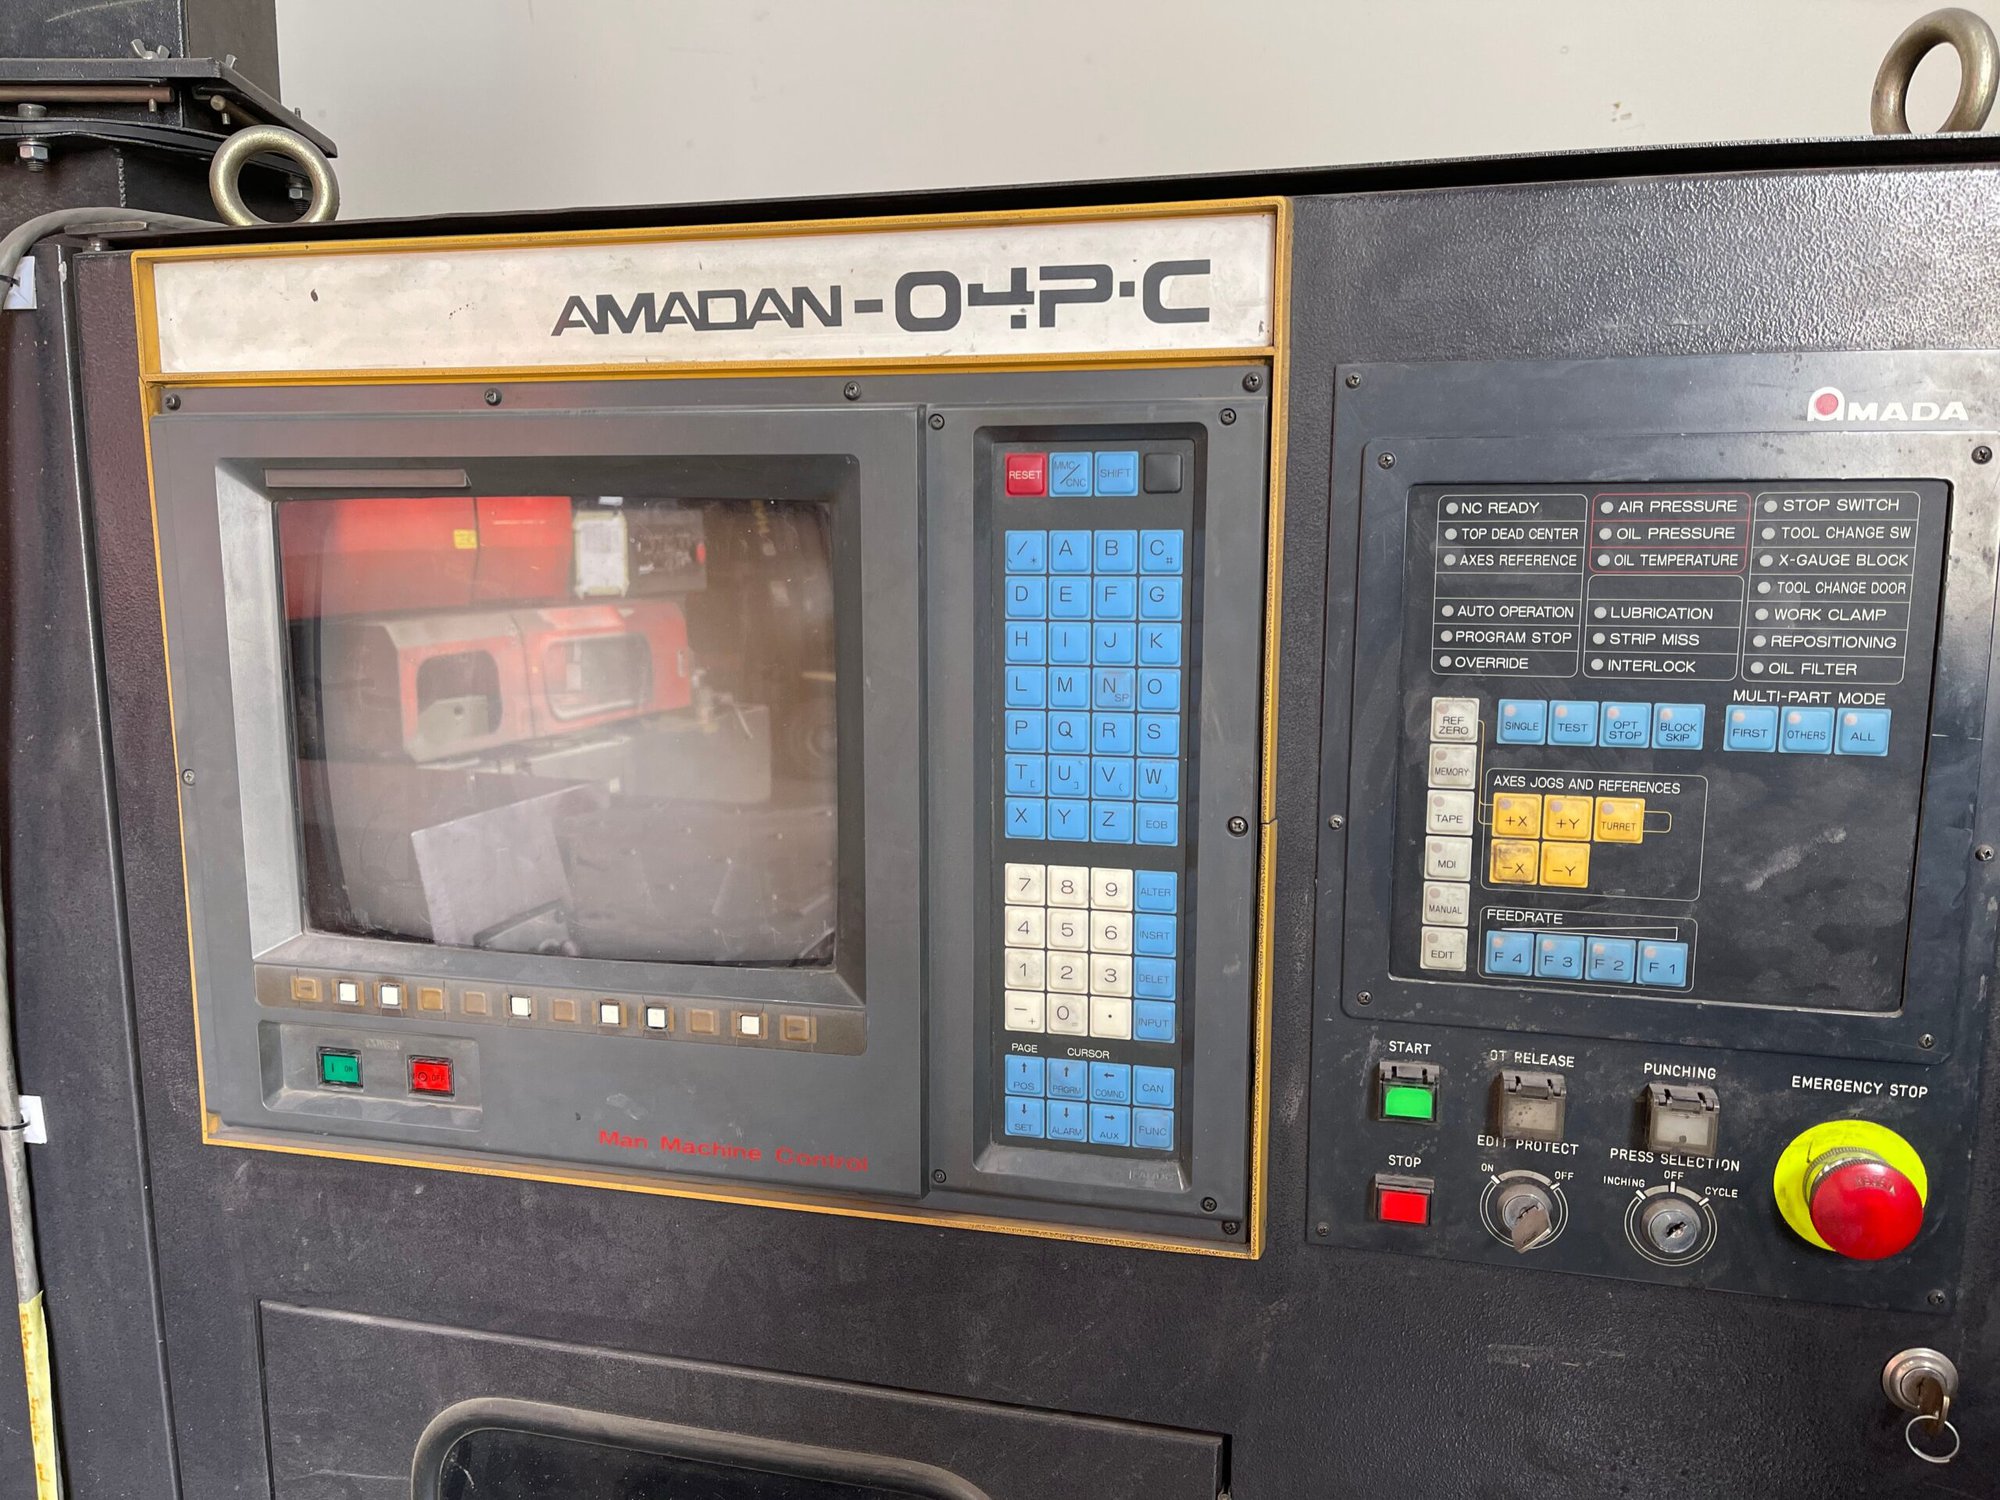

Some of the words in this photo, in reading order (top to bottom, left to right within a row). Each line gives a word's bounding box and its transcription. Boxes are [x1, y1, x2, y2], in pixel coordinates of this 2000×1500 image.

[1806, 386, 1970, 422] AMADA
[1008, 470, 1042, 480] RESET
[1099, 468, 1131, 478] SHIFT
[1461, 502, 1483, 514] NC
[1487, 502, 1540, 514] READY
[1617, 501, 1644, 513] AIR
[1649, 500, 1738, 513] PRESSURE
[1782, 498, 1830, 512] STOP
[1836, 498, 1900, 512] SWITCH
[1461, 527, 1488, 540] TOP
[1491, 528, 1525, 540] DEAD
[1528, 528, 1579, 540] CENTER
[1616, 527, 1642, 540] OIL
[1647, 527, 1736, 540] PRESSURE
[1781, 526, 1820, 539] TOOL
[1825, 526, 1885, 539] CHANGE
[1889, 526, 1912, 539] SW
[1058, 539, 1073, 556] A
[1104, 540, 1119, 556] B
[1149, 539, 1165, 556] C
[1459, 554, 1494, 566] AXES
[1499, 554, 1577, 567] REFERENCE
[1613, 554, 1635, 567] OIL
[1640, 554, 1739, 567] TEMPERATURE
[1778, 553, 1850, 567] X-GAUGE
[1856, 553, 1909, 567] BLOCK
[1015, 585, 1029, 602] D
[1059, 586, 1073, 602] E
[1104, 586, 1118, 603] F
[1149, 586, 1165, 603] G
[1777, 581, 1811, 594] TOOL
[1815, 581, 1867, 594] CHANGE
[1870, 582, 1907, 595] DOOR
[1457, 605, 1495, 618] AUTO
[1499, 605, 1574, 618] OPERATION
[1610, 606, 1714, 621] LUBRICATION
[1774, 608, 1822, 621] WORK
[1827, 608, 1887, 622] CLAMP
[1015, 630, 1028, 647] H
[1104, 632, 1117, 649] J
[1150, 632, 1164, 649] K
[1455, 630, 1526, 644] PROGRAM
[1531, 631, 1572, 644] STOP
[1609, 632, 1657, 646] STRIP
[1661, 633, 1700, 646] MISS
[1770, 635, 1897, 649] REPOSITIONING
[1454, 656, 1529, 669] OVERRIDE
[1607, 659, 1696, 673] INTERLOCK
[1768, 662, 1795, 675] OIL
[1801, 662, 1858, 676] FILTER
[1015, 675, 1028, 692] L
[1057, 676, 1073, 693] M
[1103, 677, 1116, 694] N
[1733, 689, 1832, 704] MULTI-PART
[1838, 691, 1886, 706] MODE
[1442, 715, 1465, 725] REF
[1504, 720, 1540, 731] SINGLE
[1612, 720, 1639, 730] OPT
[1015, 720, 1028, 735] P
[1057, 720, 1073, 739] Q
[1102, 722, 1116, 739] R
[1147, 723, 1161, 740] S
[1438, 725, 1469, 736] ZERO
[1557, 723, 1589, 733] TEST
[1608, 729, 1643, 740] STOP
[1660, 722, 1697, 733] BLOCK
[1732, 728, 1768, 738] FIRST
[1665, 732, 1691, 742] SKIP
[1787, 730, 1826, 741] OTHERS
[1850, 732, 1876, 742] ALL
[1015, 763, 1028, 780] T
[1058, 765, 1071, 781] U
[1101, 766, 1116, 783] V
[1145, 768, 1162, 785] W
[1434, 767, 1469, 777] MEMORY
[1493, 776, 1527, 788] AXES
[1529, 776, 1565, 790] JOGS
[1567, 778, 1595, 791] AND
[1598, 779, 1682, 795] REFERENCES
[1015, 807, 1028, 823] X
[1057, 808, 1071, 825] Y
[1102, 810, 1115, 827] Z
[1435, 813, 1464, 824] TAPE
[1145, 820, 1168, 830] EOB
[1600, 821, 1637, 832] TURRET
[1437, 859, 1457, 869] MDI
[1018, 877, 1031, 892] 7
[1060, 879, 1075, 895] 8
[1105, 882, 1118, 897] 9
[1140, 887, 1172, 897] ALTER
[1428, 904, 1463, 915] MANUAL
[1486, 909, 1564, 925] FEEDRATE
[1017, 920, 1030, 935] 4
[1061, 922, 1075, 938] 5
[1104, 925, 1118, 941] 6
[1139, 931, 1171, 941] INSRT
[1430, 949, 1455, 960] EDIT
[1019, 962, 1027, 977] 1
[1060, 965, 1074, 980] 2
[1104, 967, 1118, 983] 3
[1138, 974, 1170, 984] DELET
[1138, 1017, 1169, 1028] INPUT
[1011, 1042, 1038, 1054] PAGE
[1067, 1047, 1110, 1060] CURSOR
[1388, 1040, 1432, 1055] START
[1514, 1051, 1575, 1068] RELEASE
[1643, 1062, 1717, 1080] PUNCHING
[1013, 1081, 1035, 1092] POS
[1142, 1083, 1164, 1094] CAN
[1791, 1075, 1884, 1095] EMERGENCY
[1889, 1084, 1928, 1099] STOP
[1014, 1123, 1033, 1132] SET
[1051, 1126, 1082, 1137] ALARM
[1138, 1125, 1167, 1137] FUNC
[1099, 1130, 1120, 1140] AUX
[599, 1130, 648, 1150] Man
[660, 1135, 762, 1161] Machine
[774, 1148, 869, 1172] Control
[1516, 1139, 1580, 1156] PROTECT
[1388, 1155, 1422, 1168] STOP
[1609, 1147, 1654, 1164] PRESS
[1660, 1153, 1741, 1172] SELECTION
[1480, 1163, 1494, 1172] ON
[1554, 1170, 1575, 1181] OFF
[1603, 1176, 1646, 1188] INCHING
[1663, 1170, 1684, 1180] OFF
[1704, 1186, 1738, 1199] CYCLE
